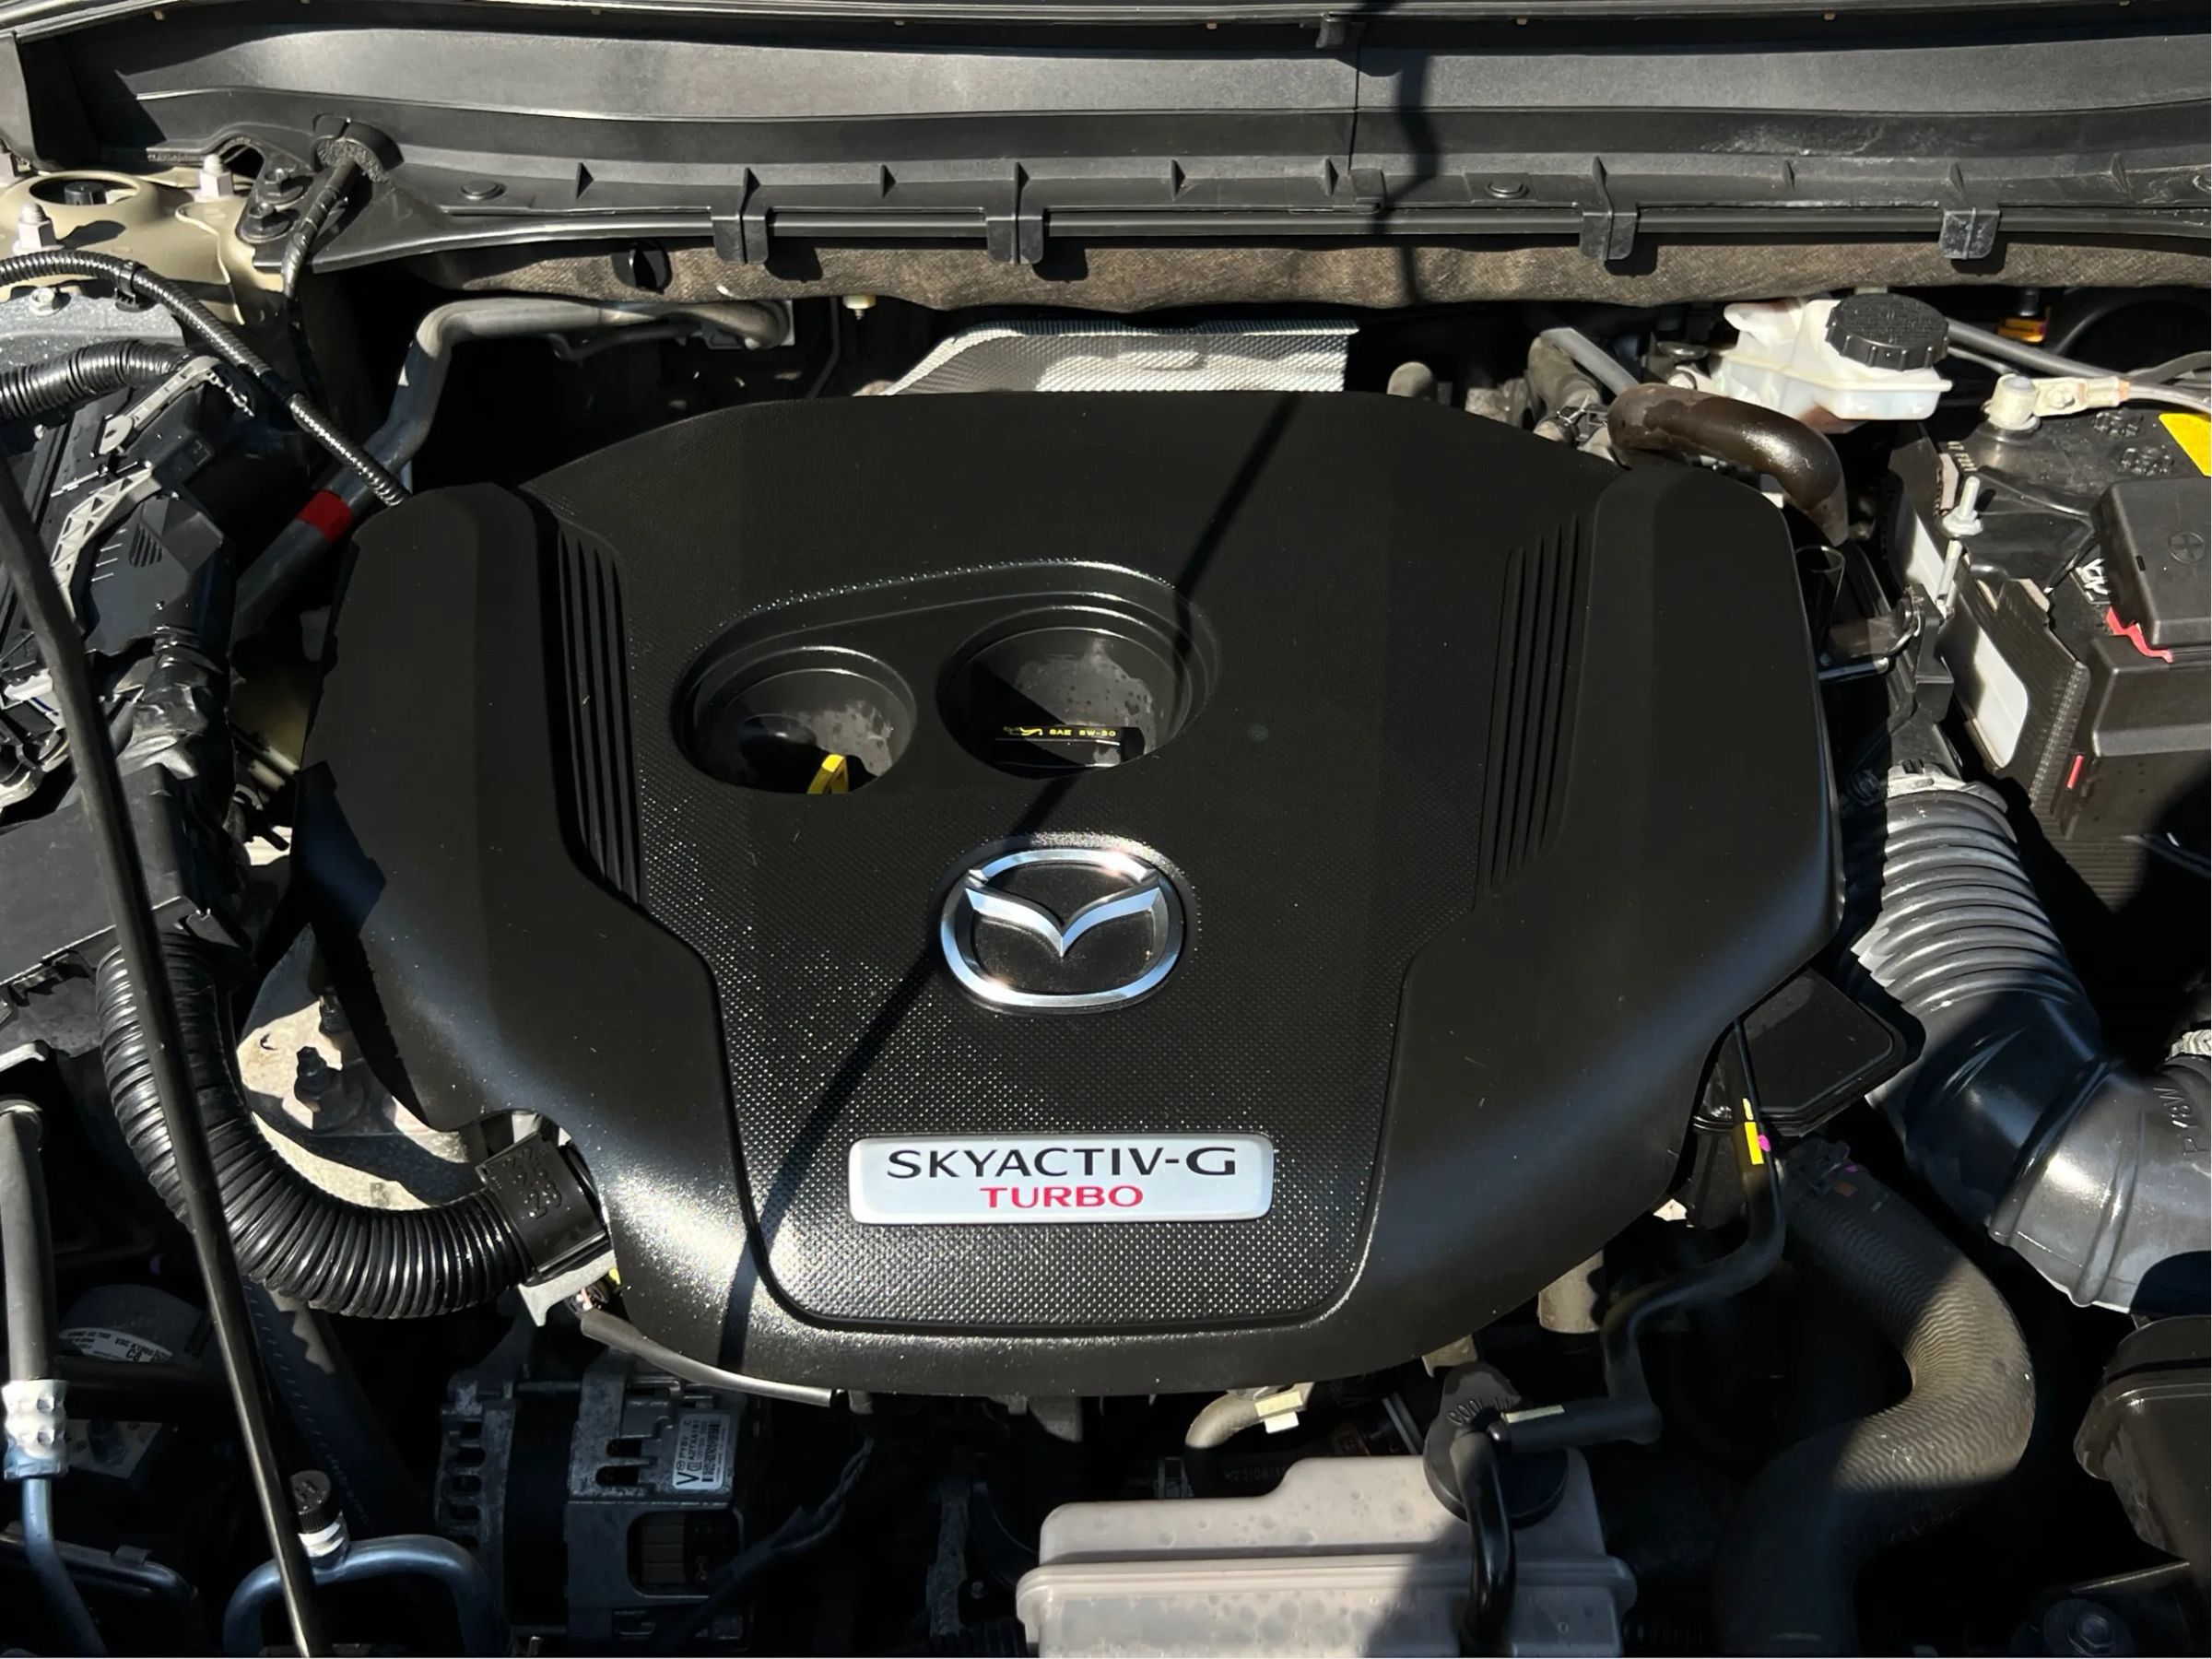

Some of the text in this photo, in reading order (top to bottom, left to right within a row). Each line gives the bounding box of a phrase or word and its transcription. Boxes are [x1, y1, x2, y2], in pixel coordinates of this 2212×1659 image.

[1049, 728, 1117, 737] SAE 5W-30
[886, 1147, 1237, 1179] SKYACTIV-G
[980, 1185, 1144, 1209] TURBO
[676, 1471, 700, 1486] V
